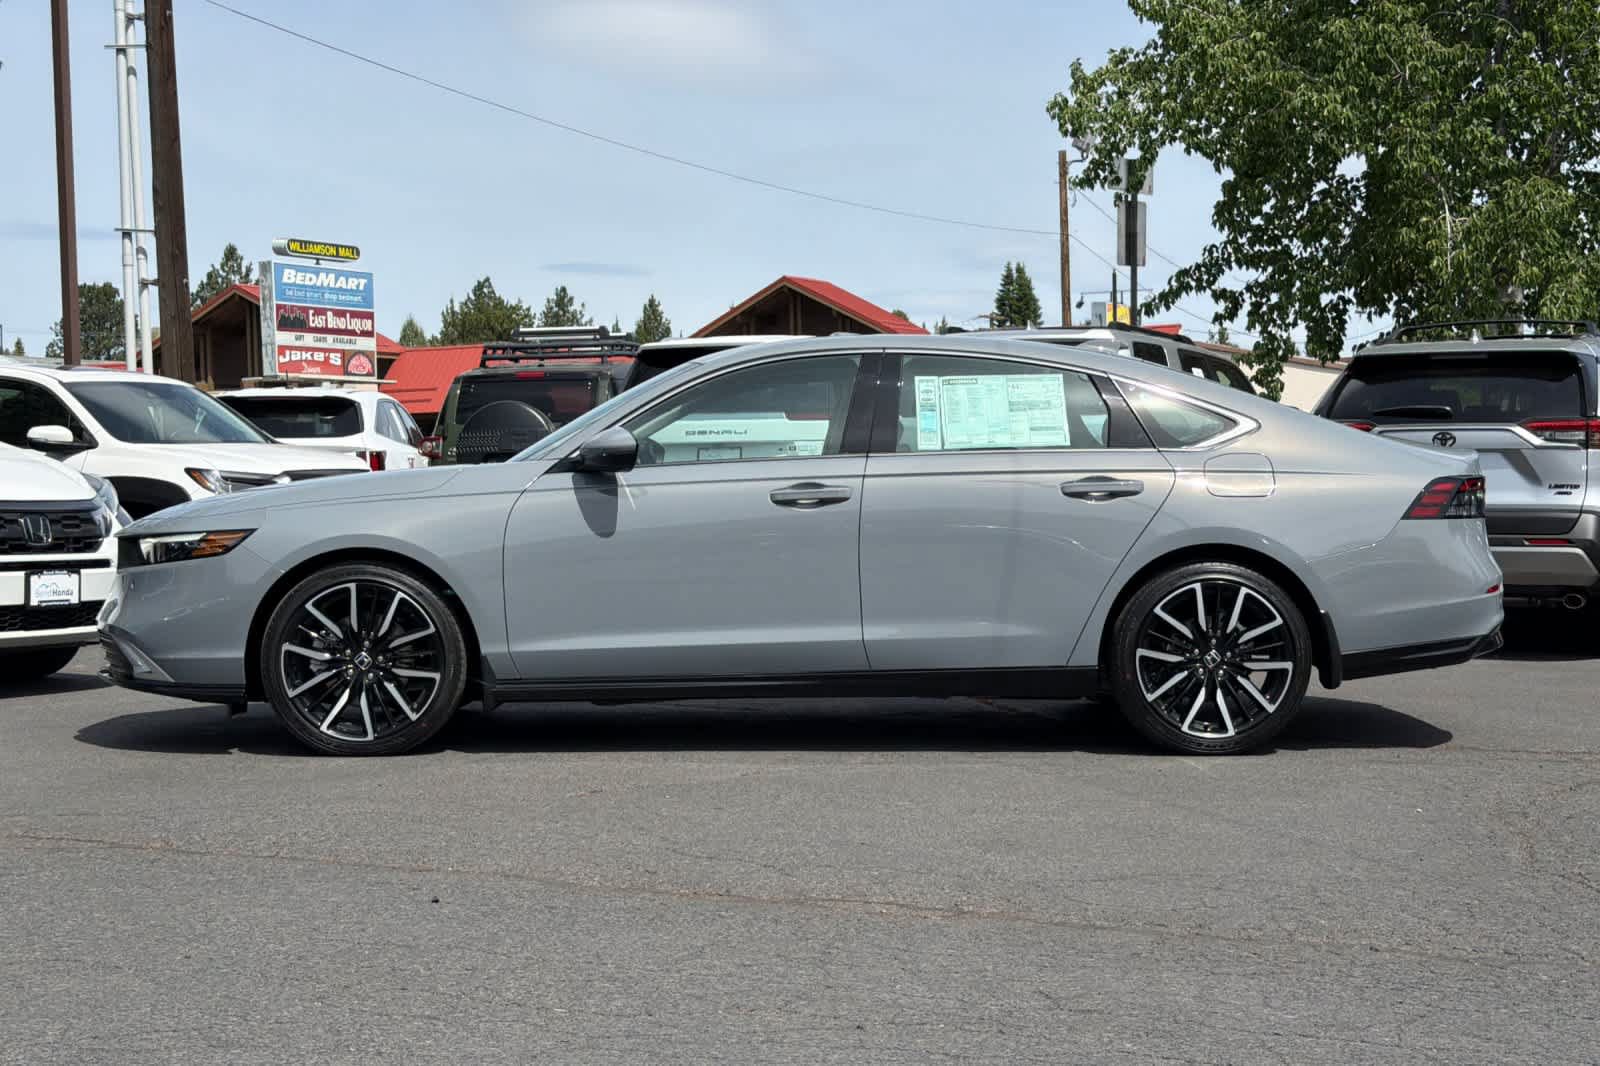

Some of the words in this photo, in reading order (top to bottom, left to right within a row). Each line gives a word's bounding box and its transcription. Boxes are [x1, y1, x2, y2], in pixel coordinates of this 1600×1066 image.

[289, 241, 336, 256] WILLIAMSON
[338, 246, 358, 258] MALL
[281, 268, 368, 290] BEDMART
[309, 309, 326, 328] EAST
[327, 311, 346, 329] BEND
[346, 313, 372, 334] LIQUOR
[52, 588, 74, 597] Honda
